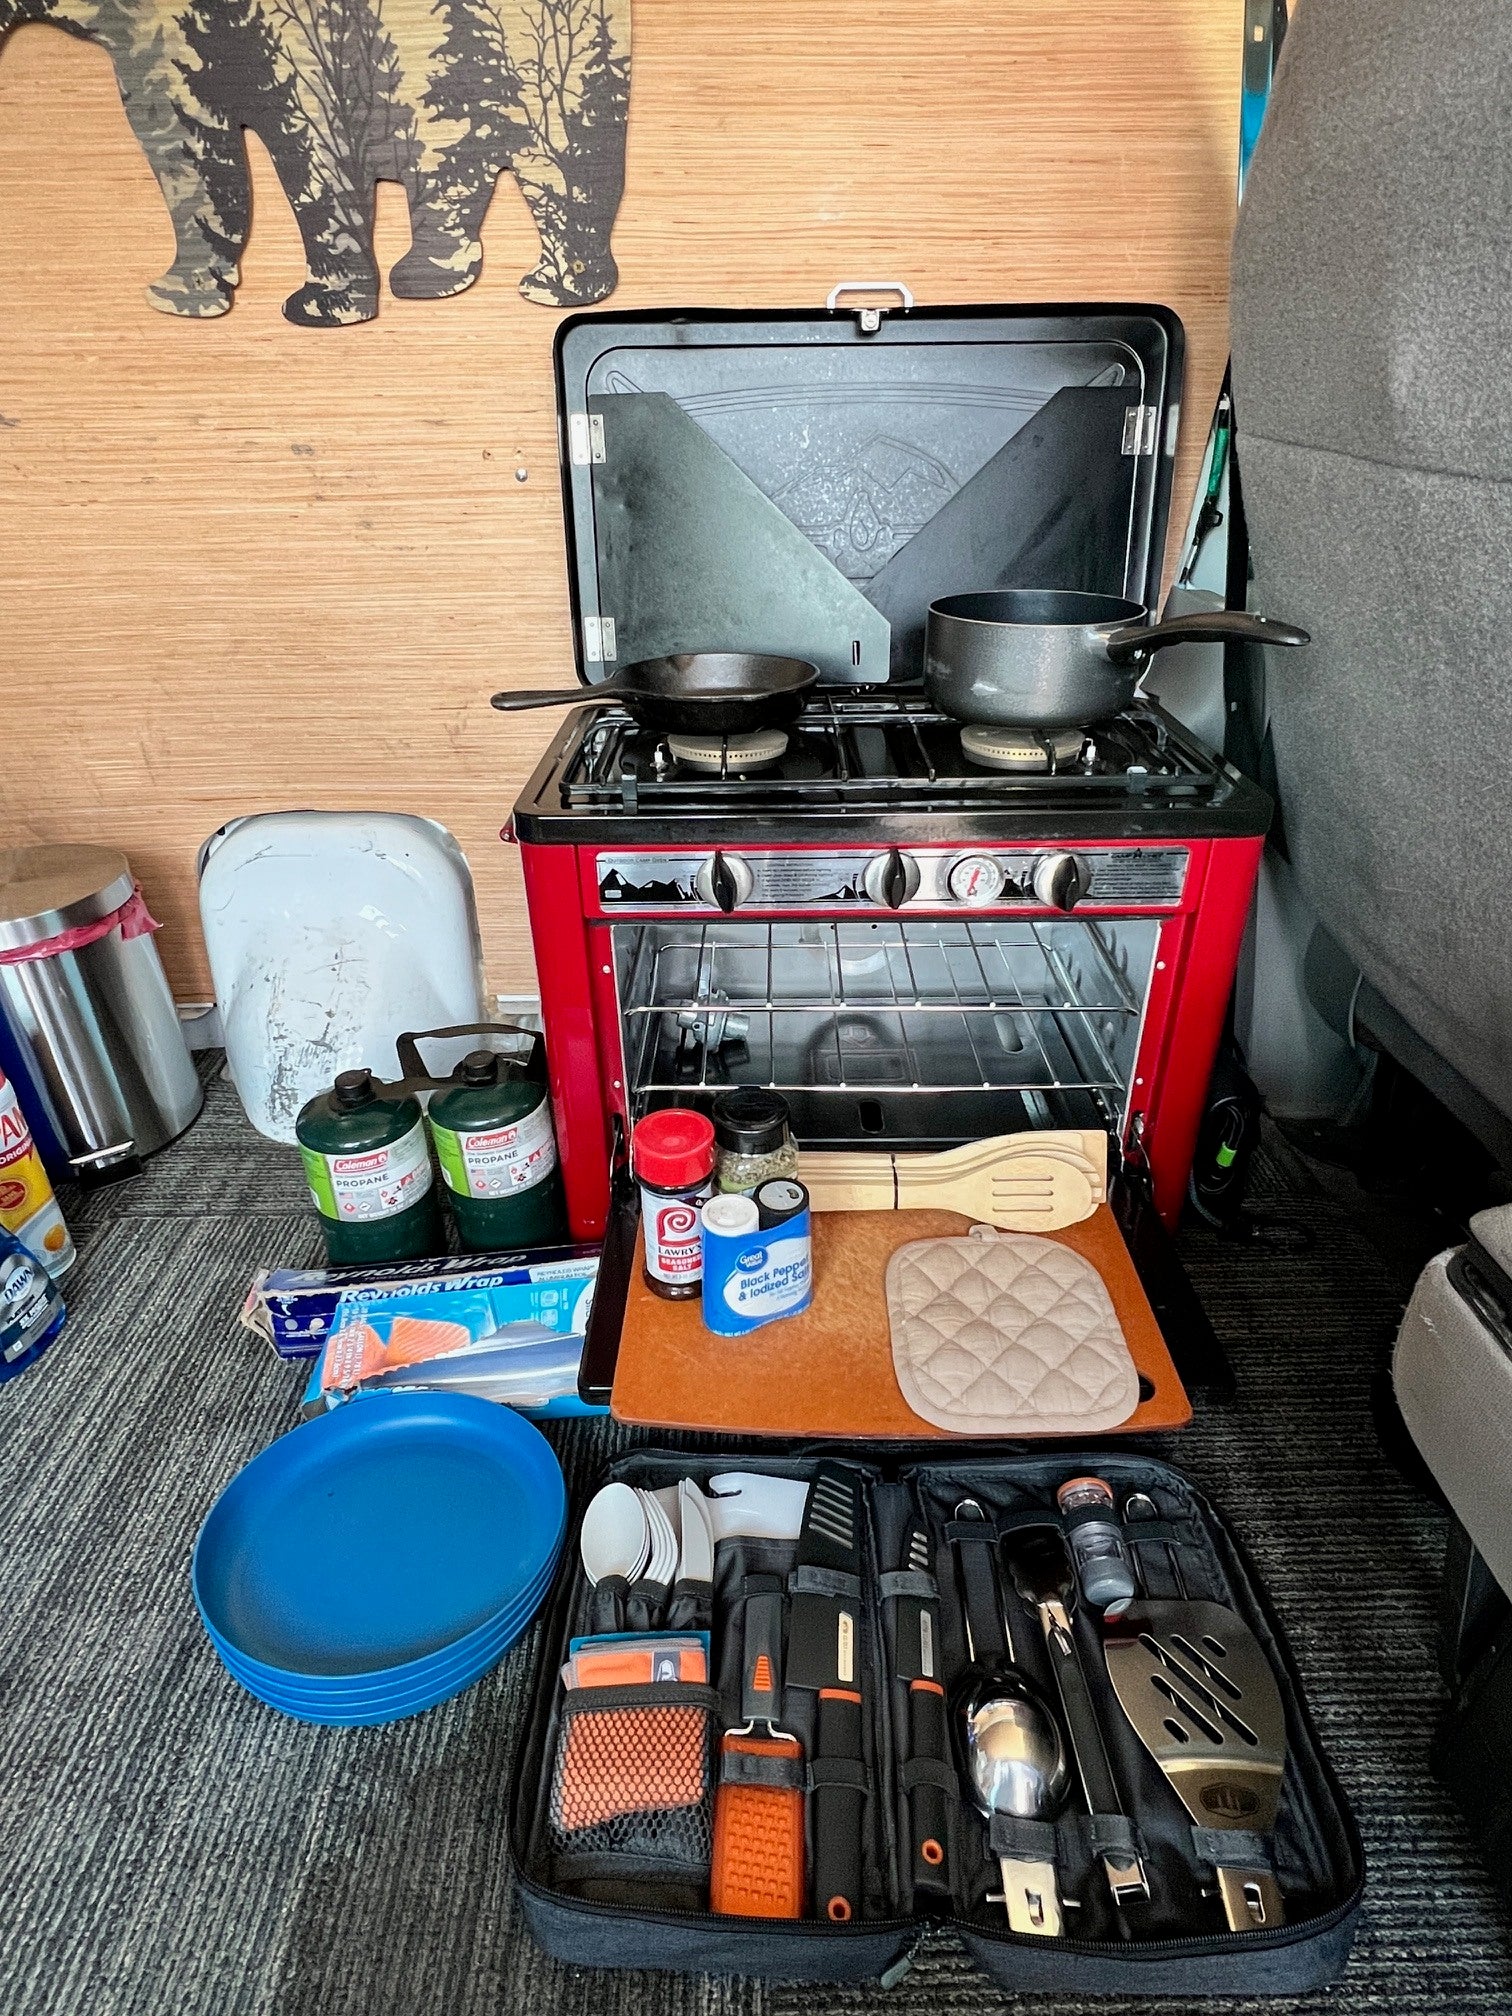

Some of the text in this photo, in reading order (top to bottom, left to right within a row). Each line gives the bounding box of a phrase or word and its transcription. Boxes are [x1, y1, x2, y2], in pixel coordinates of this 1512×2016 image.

[467, 1134, 508, 1147] Coleman
[0, 1140, 32, 1165] ORIGIN
[468, 1149, 518, 1164] PROPANE
[335, 1158, 378, 1170] Coleman
[336, 1173, 390, 1187] PROPANE
[739, 1251, 763, 1264] Great
[294, 1262, 442, 1283] Reynolds
[442, 1254, 527, 1271] Wrap
[4, 1269, 34, 1302] DAWN
[340, 1281, 442, 1303] Reynolds
[445, 1274, 504, 1293] Wrap
[738, 1292, 747, 1302] &
[750, 1277, 789, 1298] Iodized
[740, 1271, 770, 1290] Black
